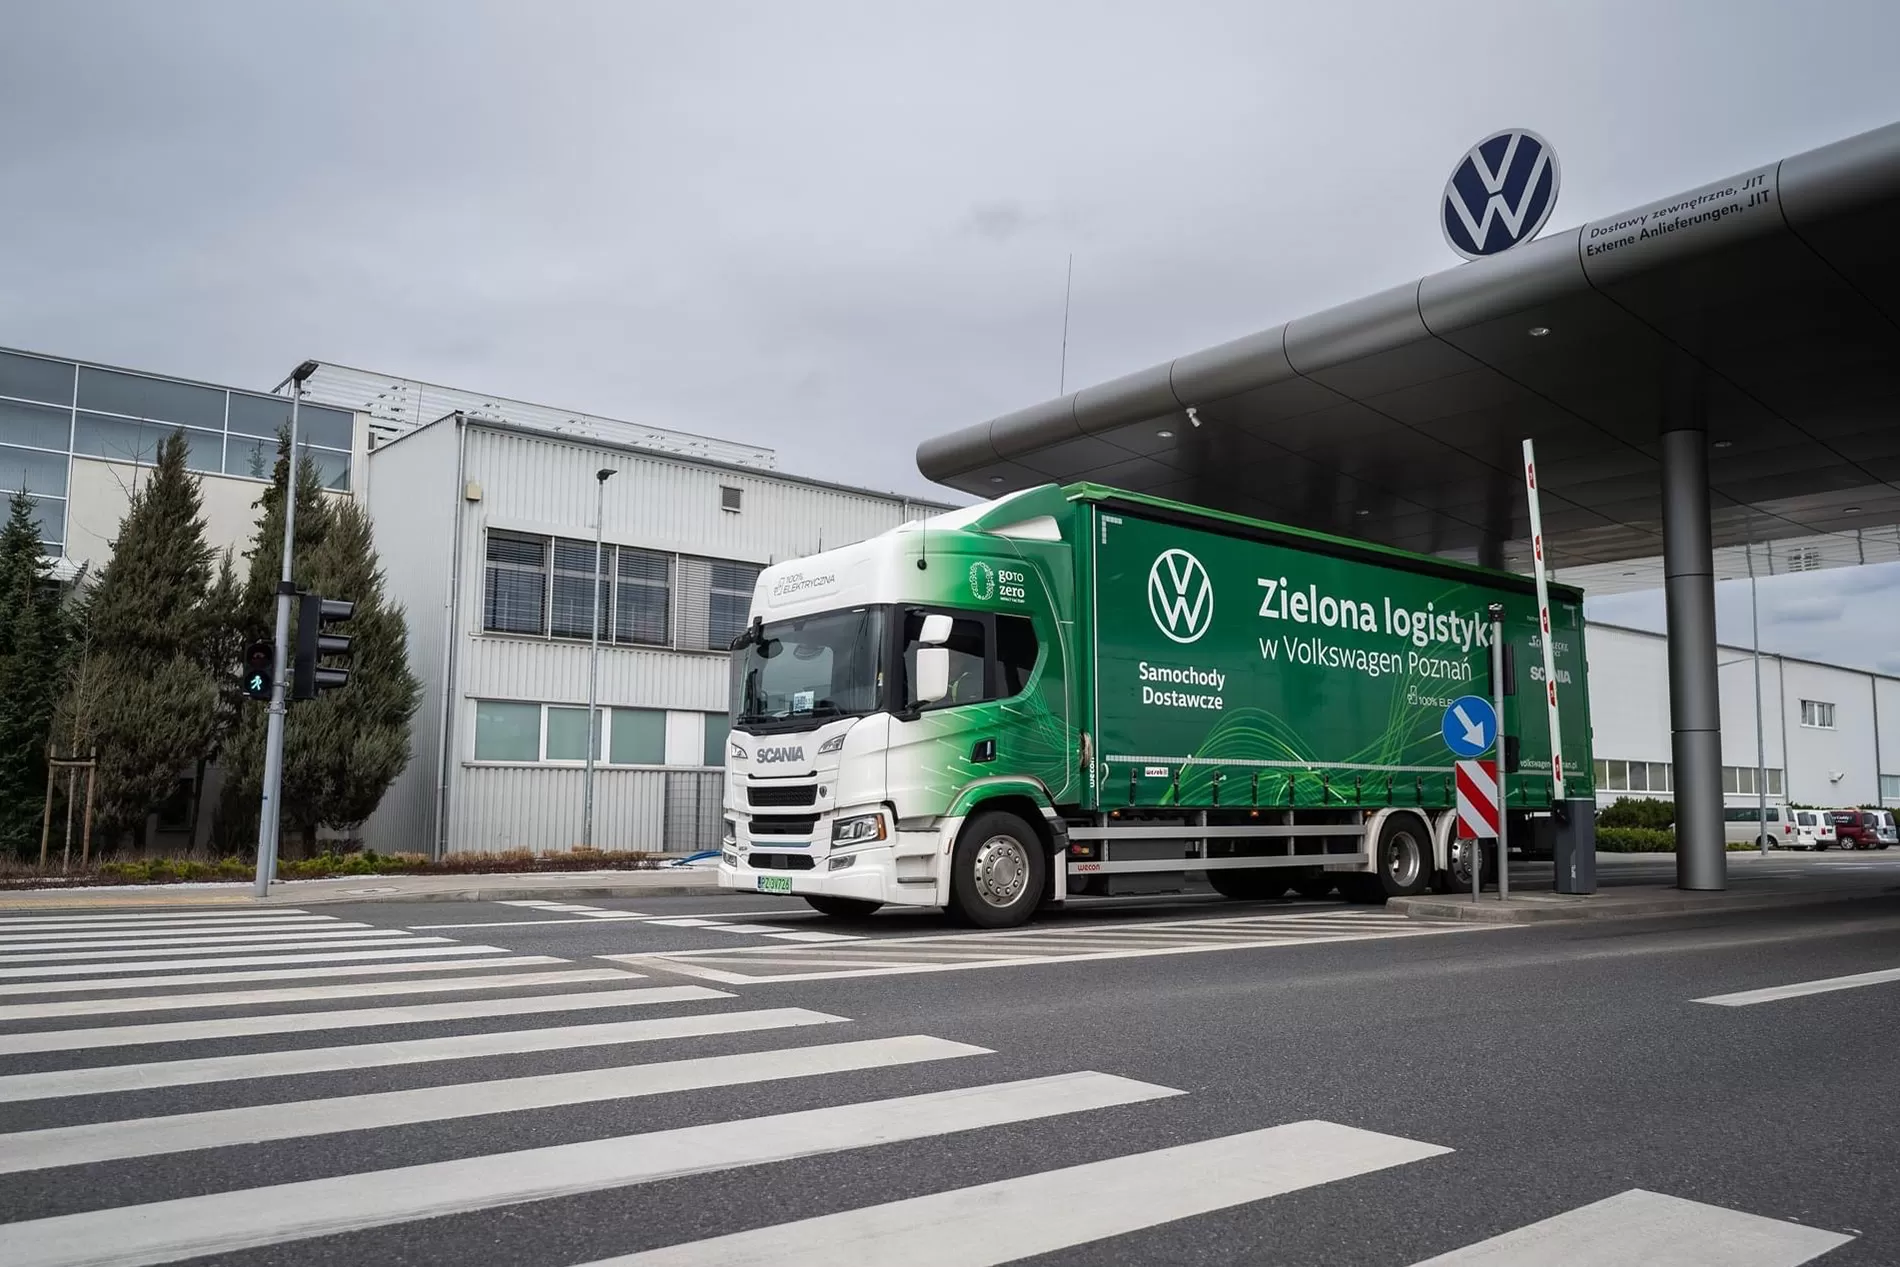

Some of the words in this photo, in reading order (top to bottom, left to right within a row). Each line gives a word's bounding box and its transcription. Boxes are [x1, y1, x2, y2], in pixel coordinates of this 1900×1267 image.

[1590, 214, 1648, 239] Dostawy
[1651, 187, 1738, 219] zewnętrzne,
[1742, 174, 1766, 190] JIT
[1586, 234, 1635, 257] Externe
[1639, 202, 1744, 241] Anlieferungen,
[1747, 189, 1770, 208] JIT
[999, 586, 1025, 598] zero
[1257, 577, 1378, 633] Zielona
[1384, 597, 1493, 652] logistyk
[1259, 638, 1278, 660] w
[1283, 635, 1402, 677] Volkswagen
[1408, 652, 1472, 681] Poznań
[1139, 662, 1225, 691] Samochody
[1530, 666, 1572, 684] SCNIA
[1142, 686, 1223, 709] Dostawcze
[756, 746, 804, 763] SCANIA
[1077, 863, 1101, 871] wecon
